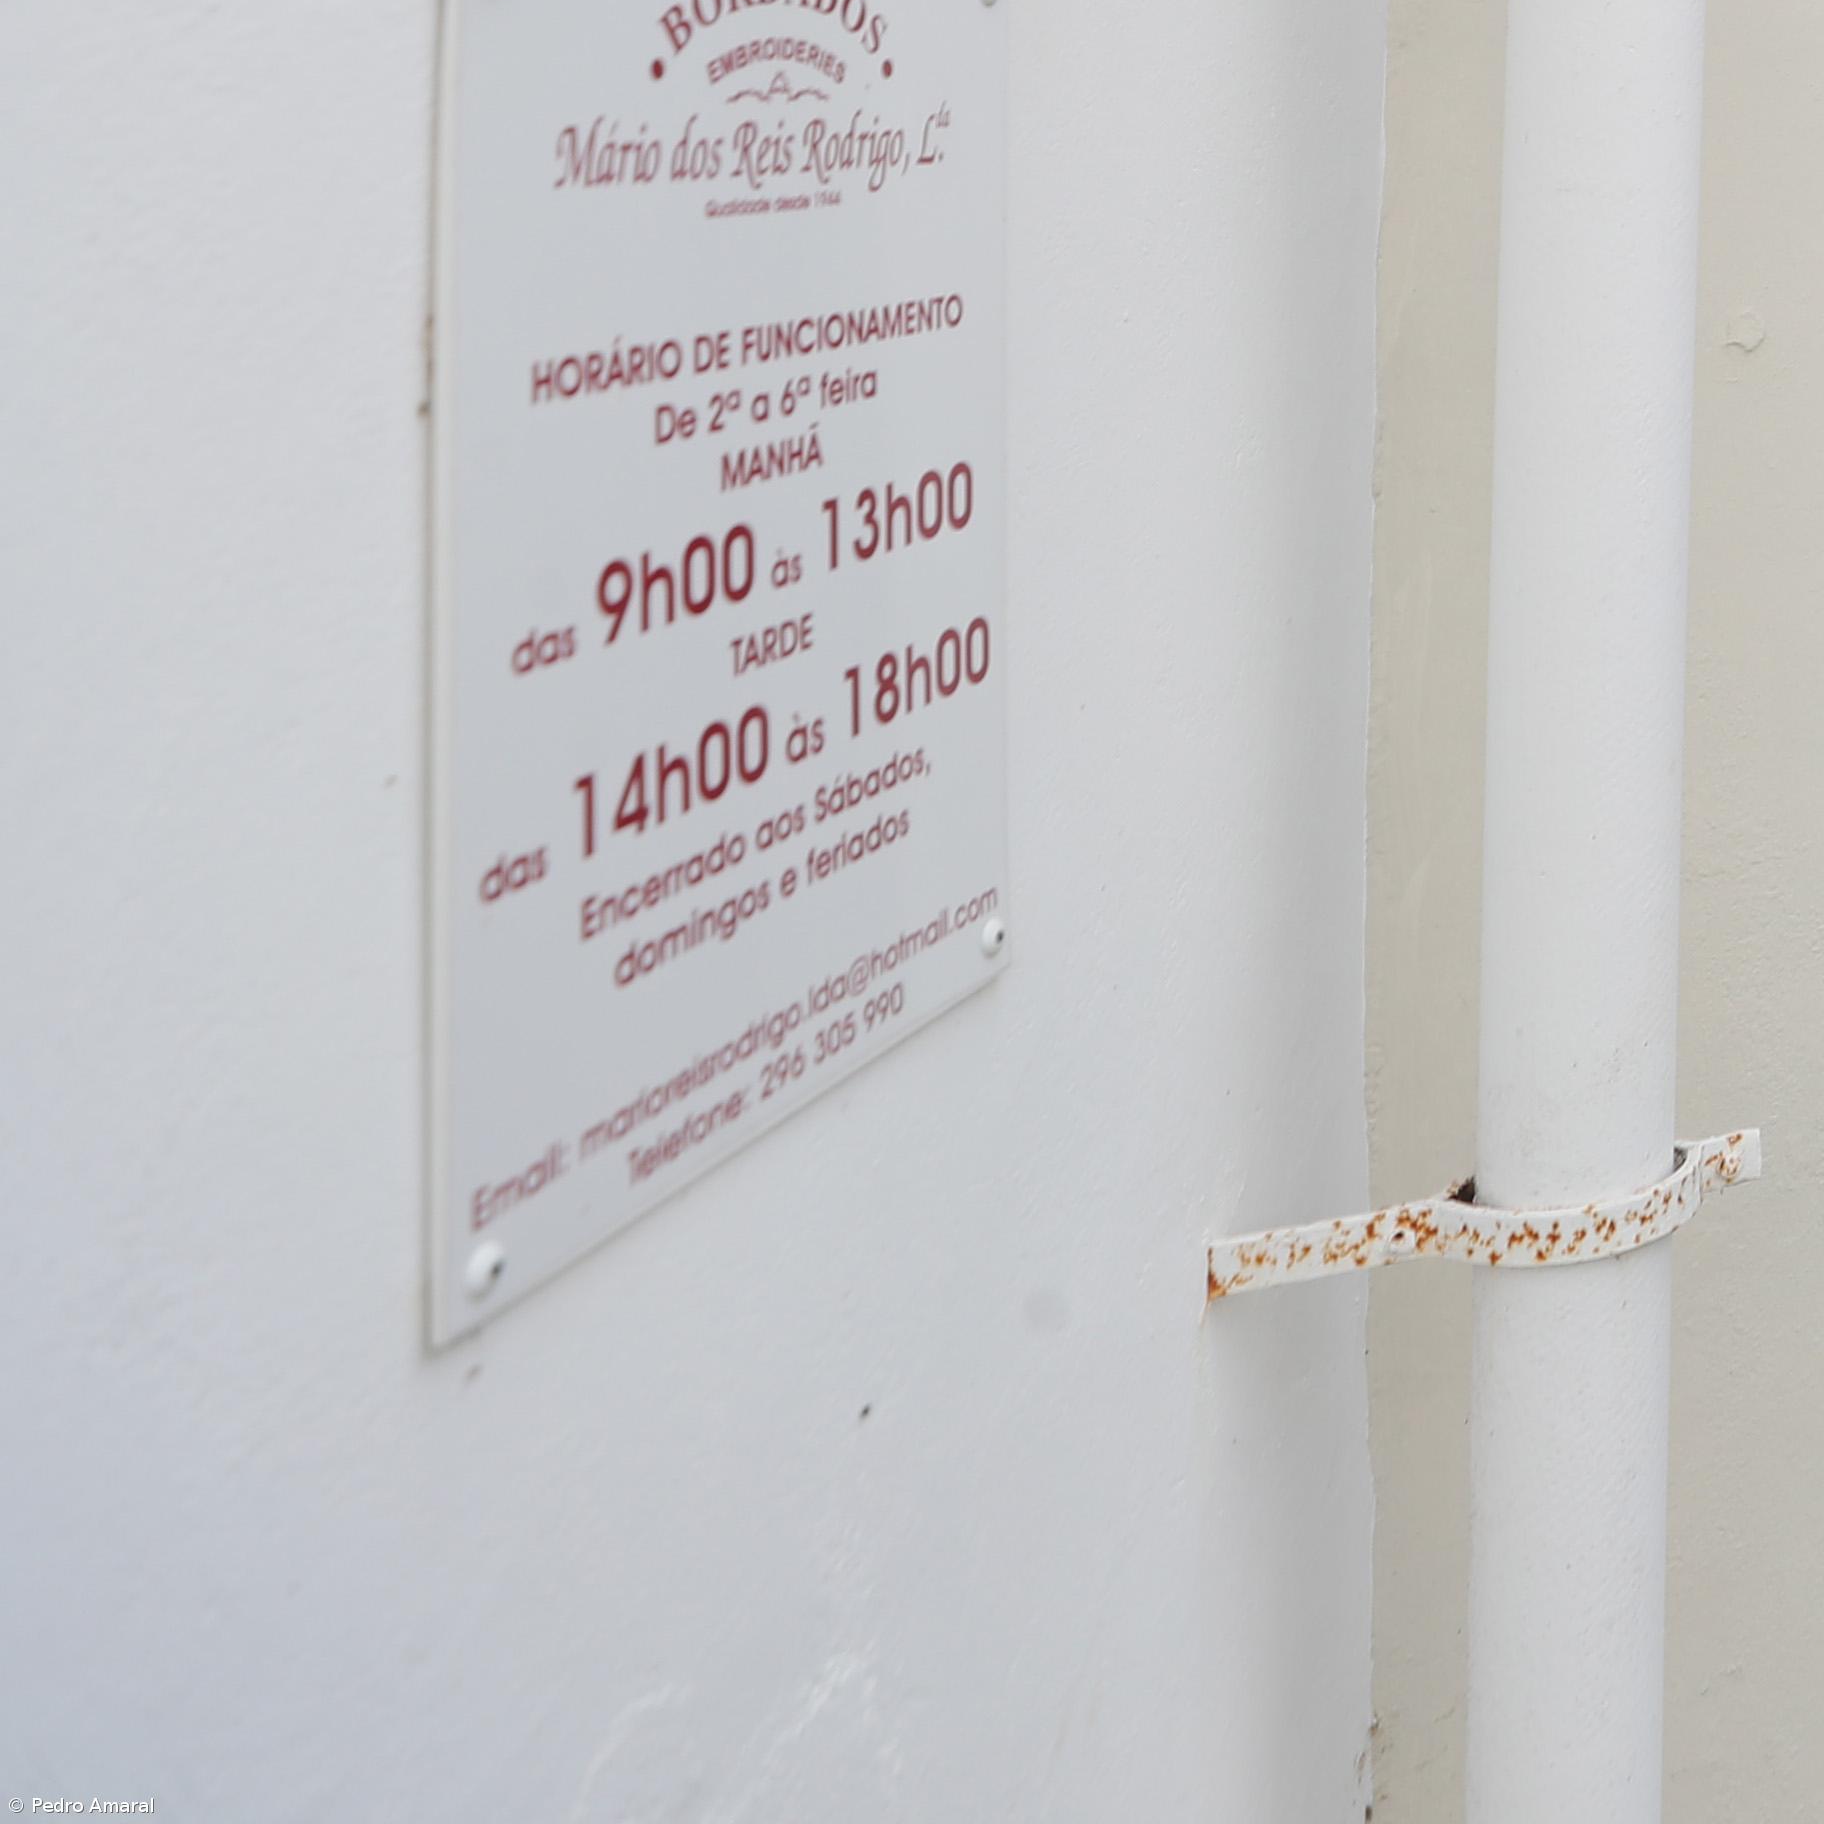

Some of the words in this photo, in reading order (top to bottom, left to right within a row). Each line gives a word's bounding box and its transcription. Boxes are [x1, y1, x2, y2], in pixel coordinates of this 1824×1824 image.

[706, 37, 846, 84] EMBROIDERIES
[554, 114, 662, 190] Mário
[670, 113, 723, 184] dos
[733, 119, 796, 191] Reis
[801, 109, 911, 194] Rodrigo,
[530, 333, 682, 405] HORÁRIO
[692, 328, 731, 372] DE
[740, 293, 965, 367] FUNCIONAMENTO
[654, 403, 697, 446] De
[706, 388, 742, 435] 2ª
[749, 393, 771, 425] a
[780, 377, 811, 419] 6ª
[818, 368, 878, 410] feira
[510, 623, 577, 676] das
[595, 522, 756, 648] 9h00
[770, 547, 803, 589] às
[821, 460, 975, 571] 13h00
[728, 612, 815, 677] TARDE
[479, 845, 549, 906] das
[573, 703, 771, 860] 14h00
[785, 711, 825, 764] às
[843, 616, 992, 739] 18h00
[578, 830, 747, 942] Encerrado
[756, 804, 807, 853] aos
[814, 746, 932, 825] Sábados,
[613, 878, 772, 990] domingos
[779, 867, 797, 900] e
[806, 806, 911, 888] feriados
[760, 1044, 807, 1101] 296
[813, 1010, 856, 1065] 305
[863, 981, 905, 1034] 990
